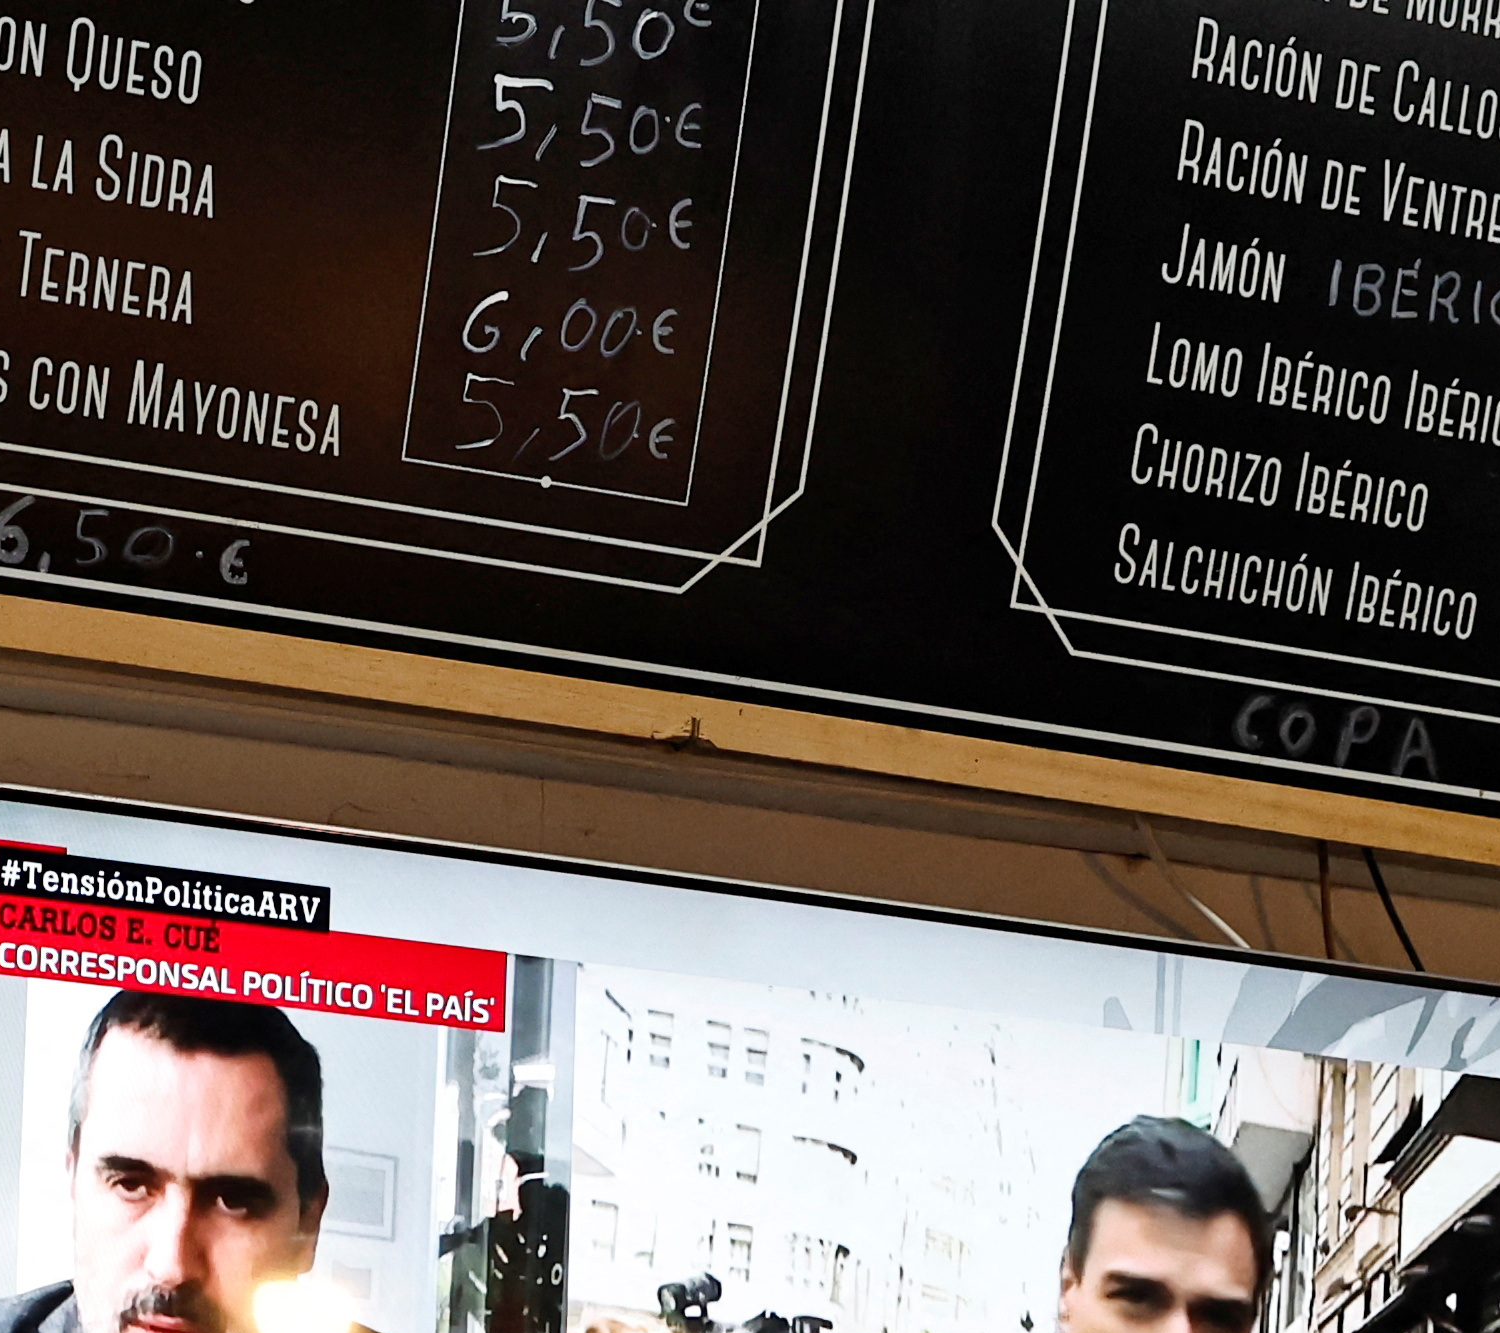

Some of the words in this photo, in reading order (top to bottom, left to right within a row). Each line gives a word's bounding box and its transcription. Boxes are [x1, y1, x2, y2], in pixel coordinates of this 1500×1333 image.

[67, 17, 201, 104] QUESO
[1192, 17, 1322, 103] RACIÓN
[1336, 59, 1380, 115] DE
[32, 135, 72, 194] LA
[96, 134, 213, 218] SIDRA
[1177, 119, 1308, 204] RACIÓN
[1321, 160, 1366, 215] DE
[20, 230, 191, 324] TERNERA
[1162, 223, 1285, 303] JAMÓN
[30, 357, 109, 419] CON
[127, 360, 339, 456] MAYONESA
[1147, 322, 1242, 397] LOMO
[1257, 343, 1391, 424] IBÉRICO
[1131, 423, 1281, 506] CHORIZO
[1295, 452, 1428, 531] IBÉRICO
[1114, 523, 1333, 616] SALCHICHÓN
[1345, 562, 1477, 639] IBÉRICO
[0, 859, 320, 924] #TensiónPolíticaARV
[126, 919, 152, 945] E.
[163, 921, 221, 953] CUÉ
[243, 970, 373, 1011] POLÍTICO
